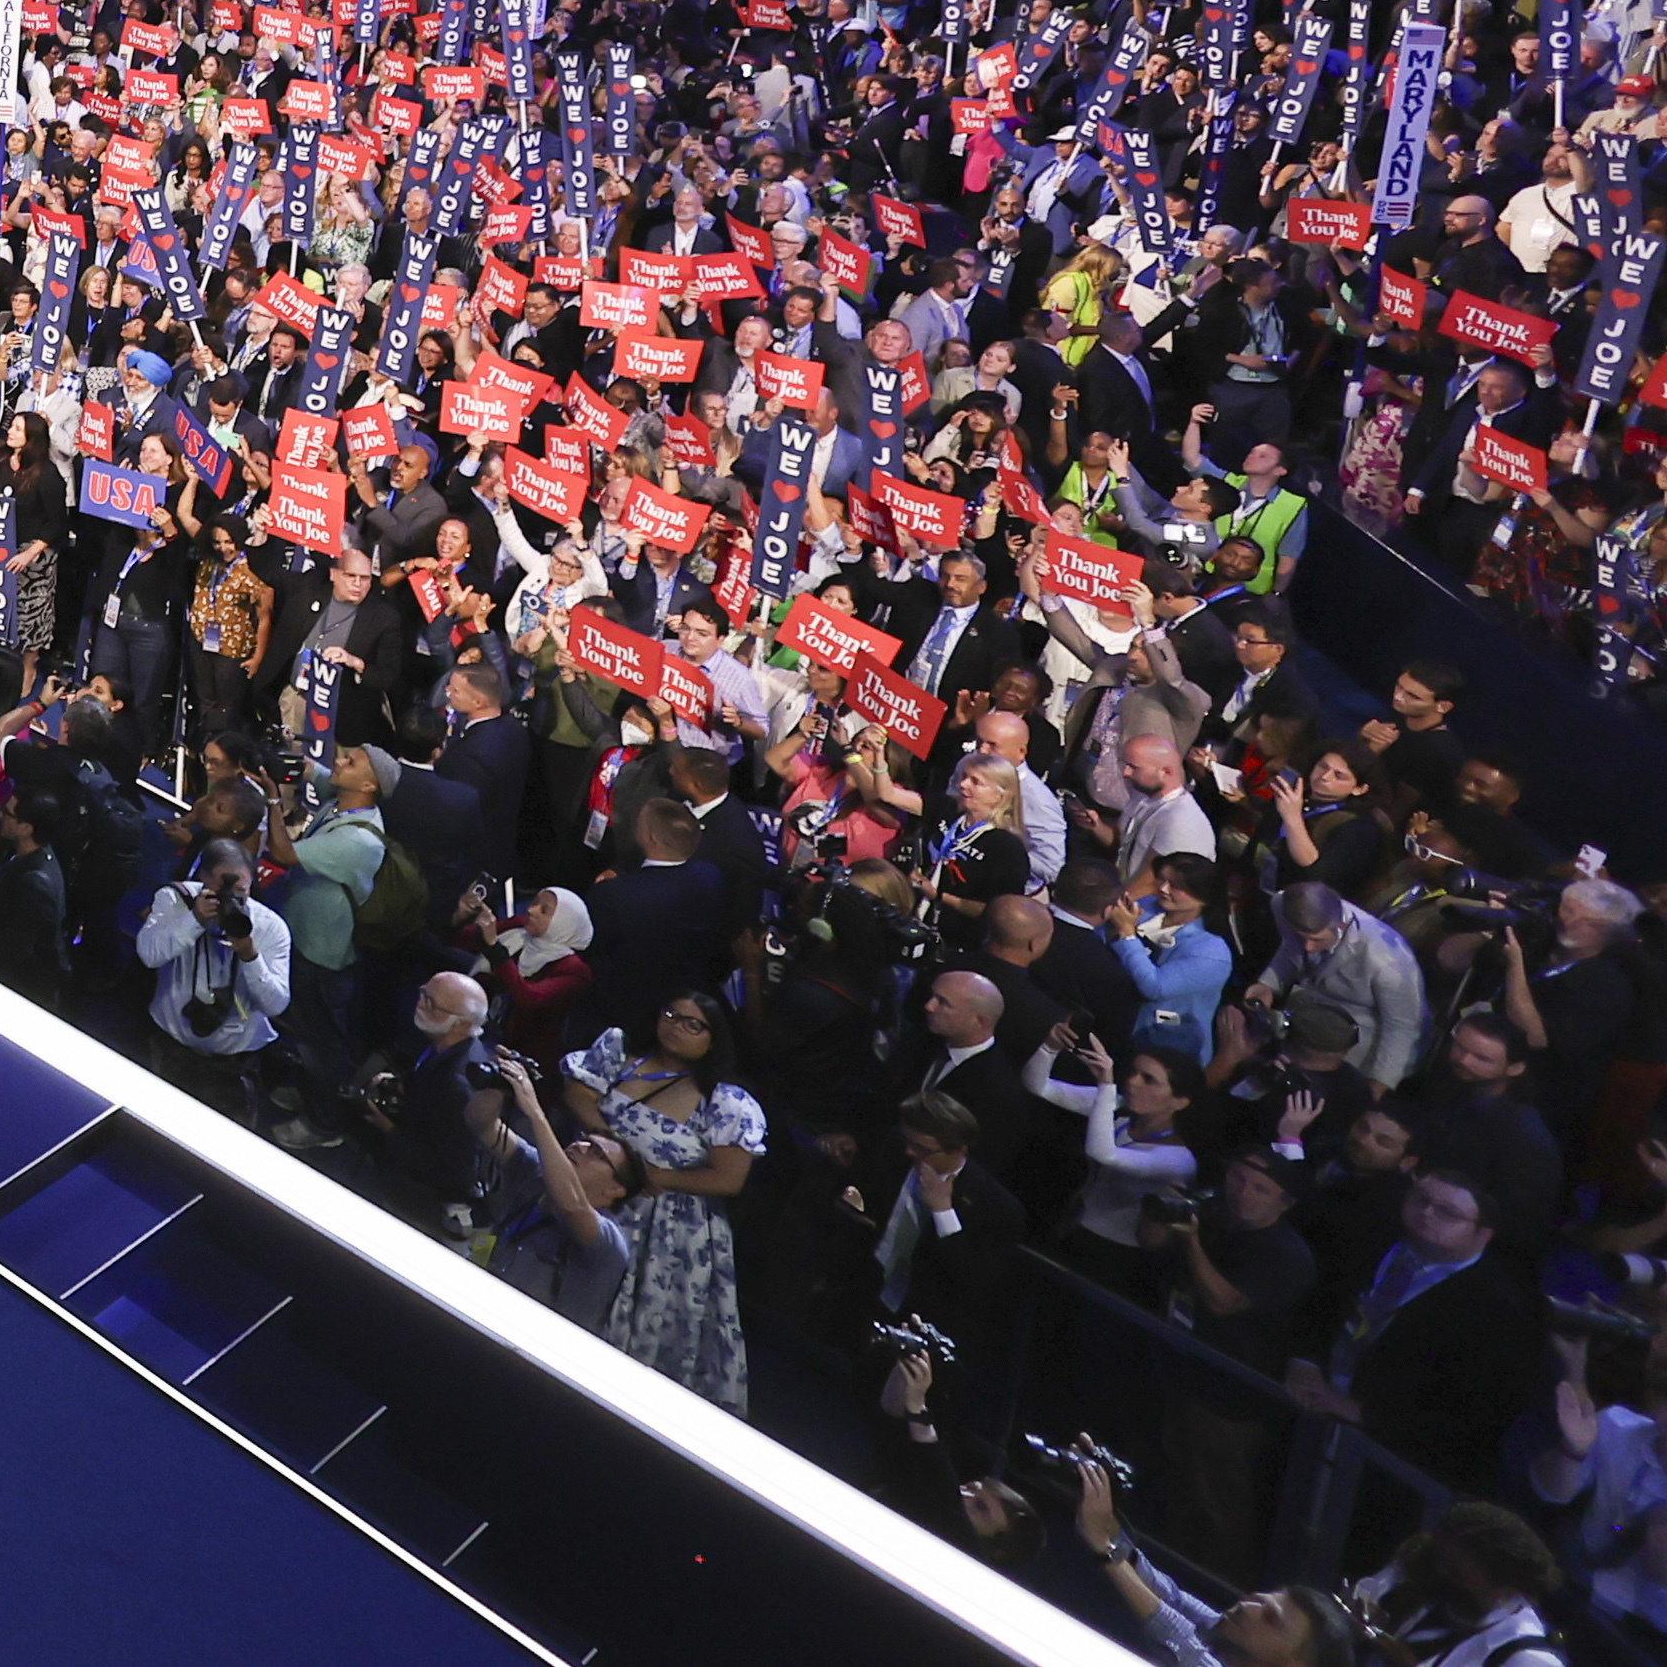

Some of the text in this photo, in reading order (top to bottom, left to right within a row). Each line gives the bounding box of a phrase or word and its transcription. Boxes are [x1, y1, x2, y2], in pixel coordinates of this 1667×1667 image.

[1385, 49, 1436, 199] MARYLAND
[1299, 221, 1360, 242] You Joe
[1302, 207, 1360, 228] Thank
[1617, 233, 1660, 286] WE
[1454, 318, 1529, 356] You Joe
[1465, 305, 1533, 343] Thank
[1588, 317, 1627, 390] JOE
[175, 410, 218, 478] USA
[780, 421, 814, 478] WE
[89, 470, 158, 517] USA
[636, 490, 691, 528] Thank
[627, 509, 687, 545] You Joe
[761, 513, 790, 586] JOE
[1052, 566, 1122, 603] You Joe
[1058, 546, 1121, 584] Thank
[576, 640, 645, 687] You Joe
[583, 624, 643, 669] Thank
[854, 684, 922, 742] You Joe
[864, 668, 922, 721] Thank
